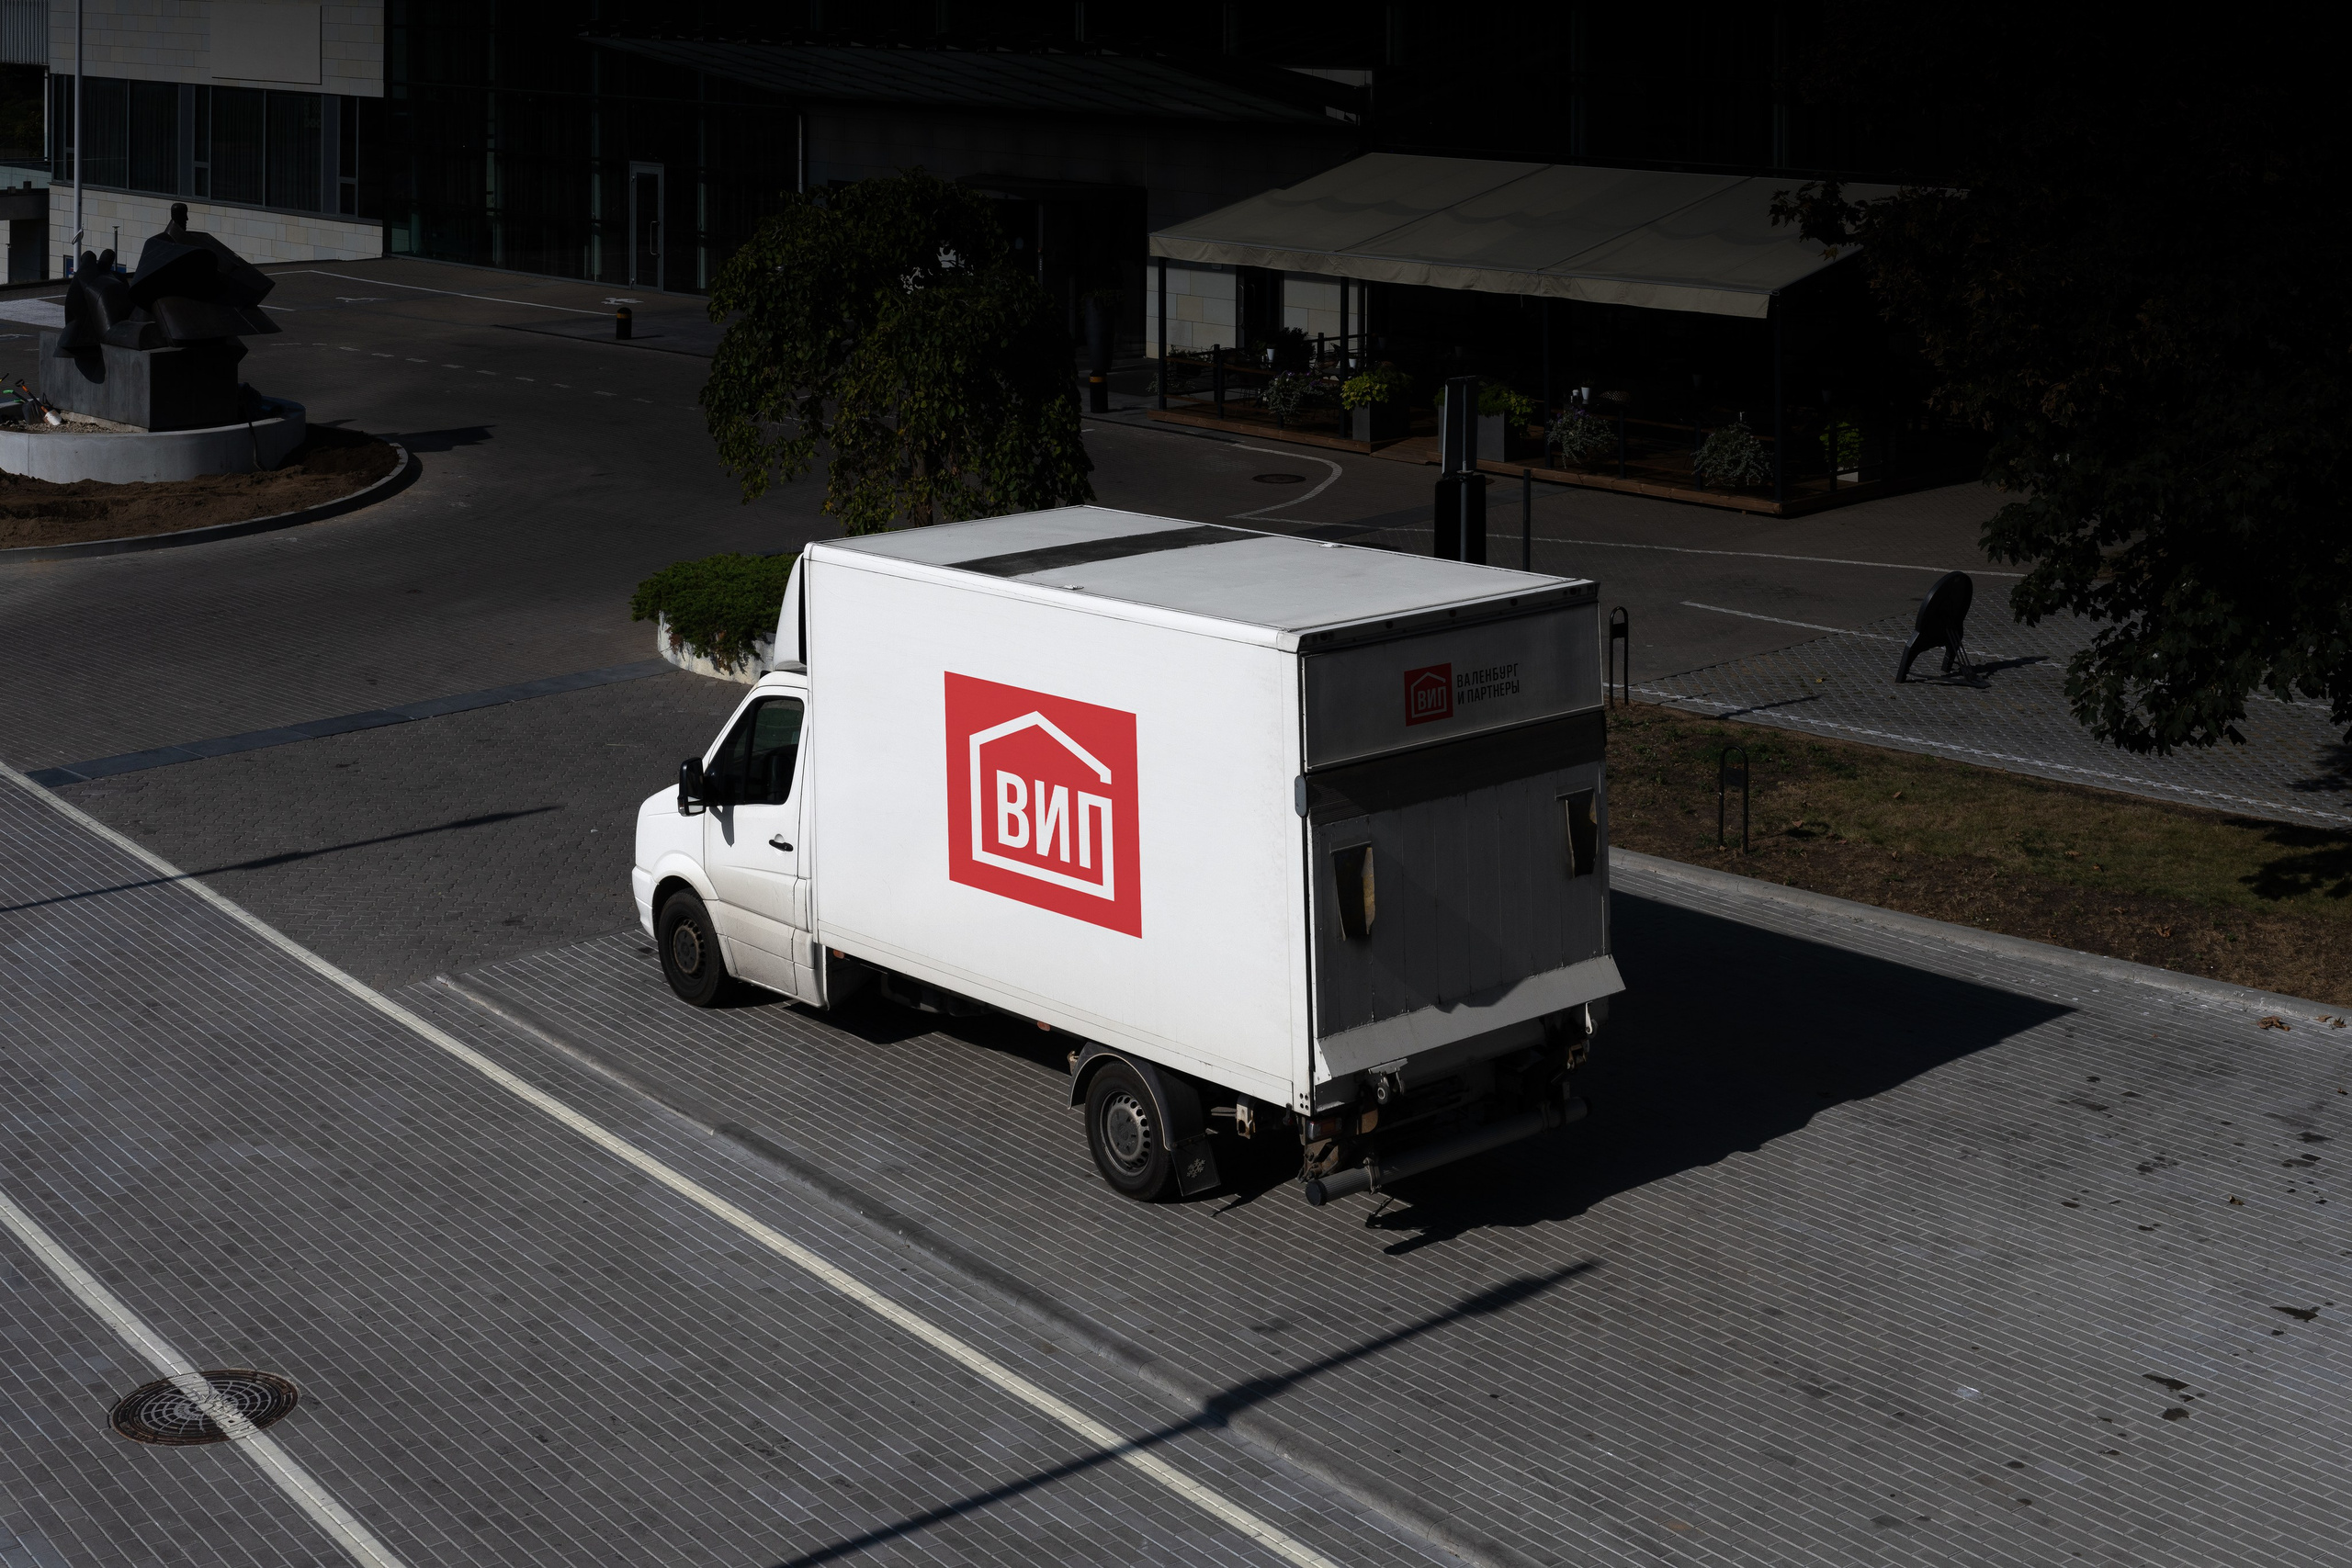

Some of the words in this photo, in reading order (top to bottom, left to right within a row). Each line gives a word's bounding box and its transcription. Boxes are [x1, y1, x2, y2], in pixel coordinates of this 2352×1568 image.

[1457, 663, 1519, 688] ВАЛЕНБУРГ
[1418, 686, 1447, 711] ВИП
[1457, 692, 1464, 705] И
[1467, 680, 1520, 704] ПАРТНЕРЫ
[996, 769, 1114, 871] ВИП
